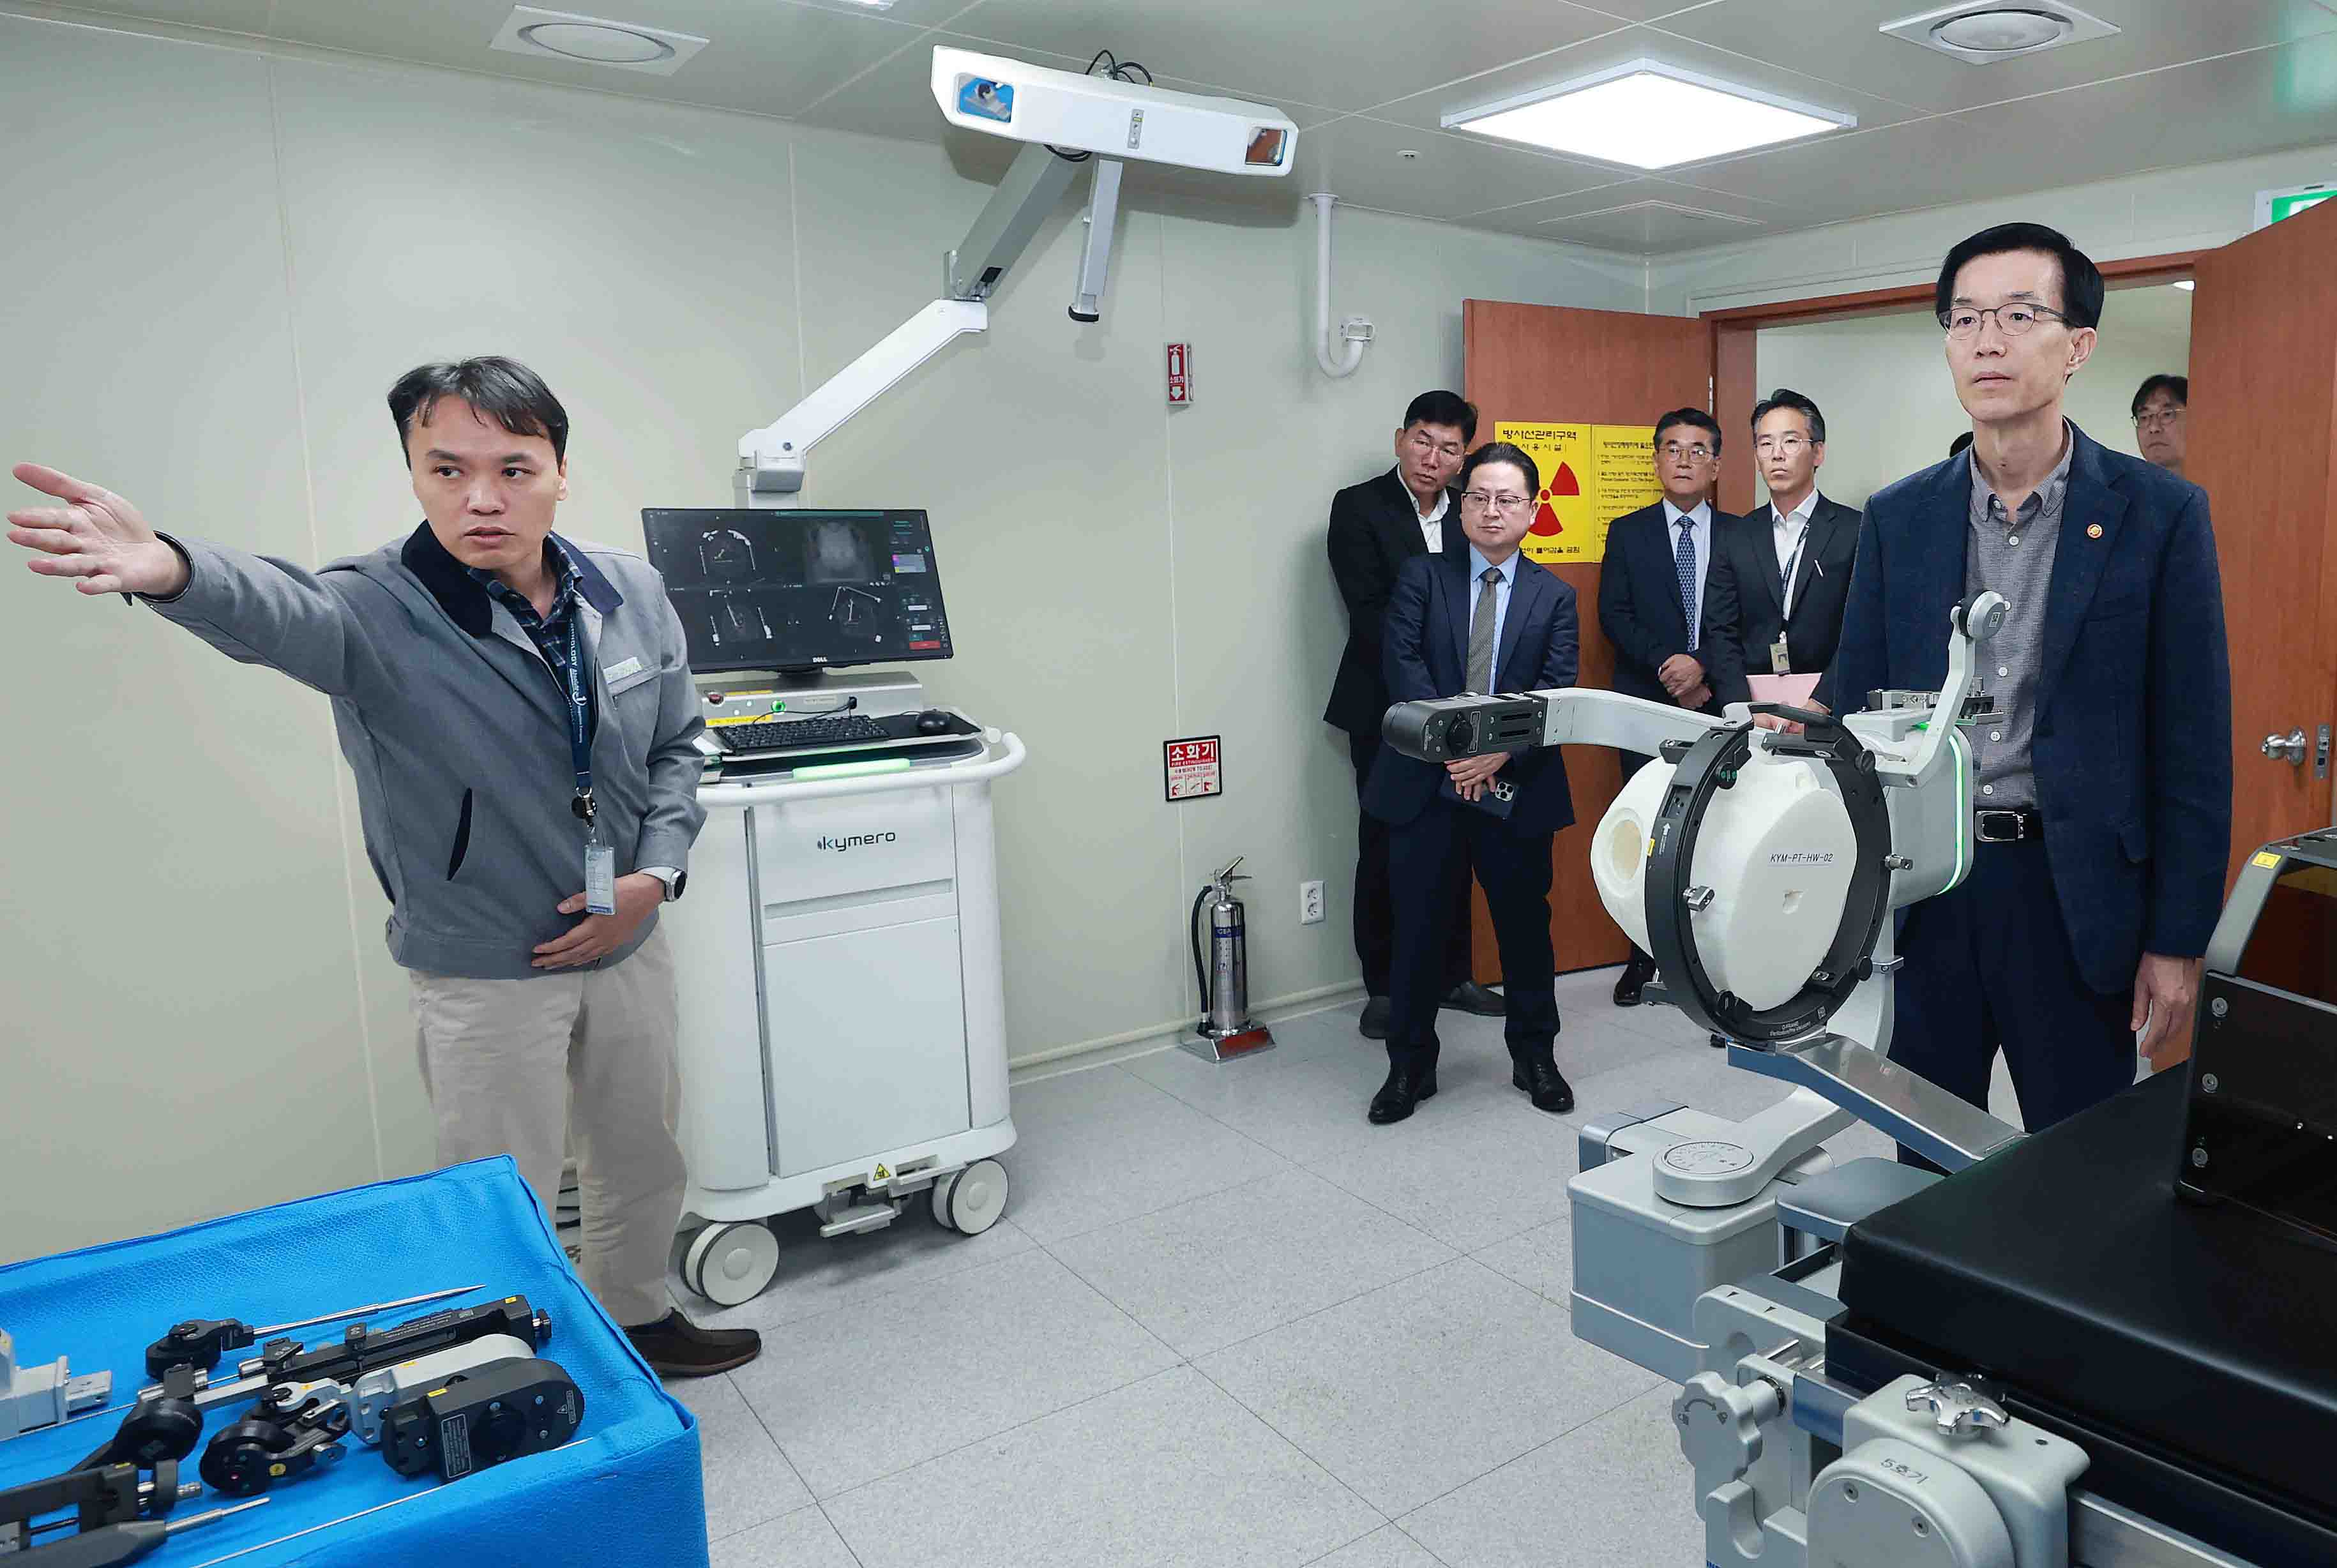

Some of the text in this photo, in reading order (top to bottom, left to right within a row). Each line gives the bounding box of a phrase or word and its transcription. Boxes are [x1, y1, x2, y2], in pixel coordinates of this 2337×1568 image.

[1502, 430, 1577, 441] 방사선관리구역
[1171, 743, 1214, 762] 소화기
[822, 832, 896, 852] kymero
[1770, 854, 1834, 863] KYM-PT-HW-02
